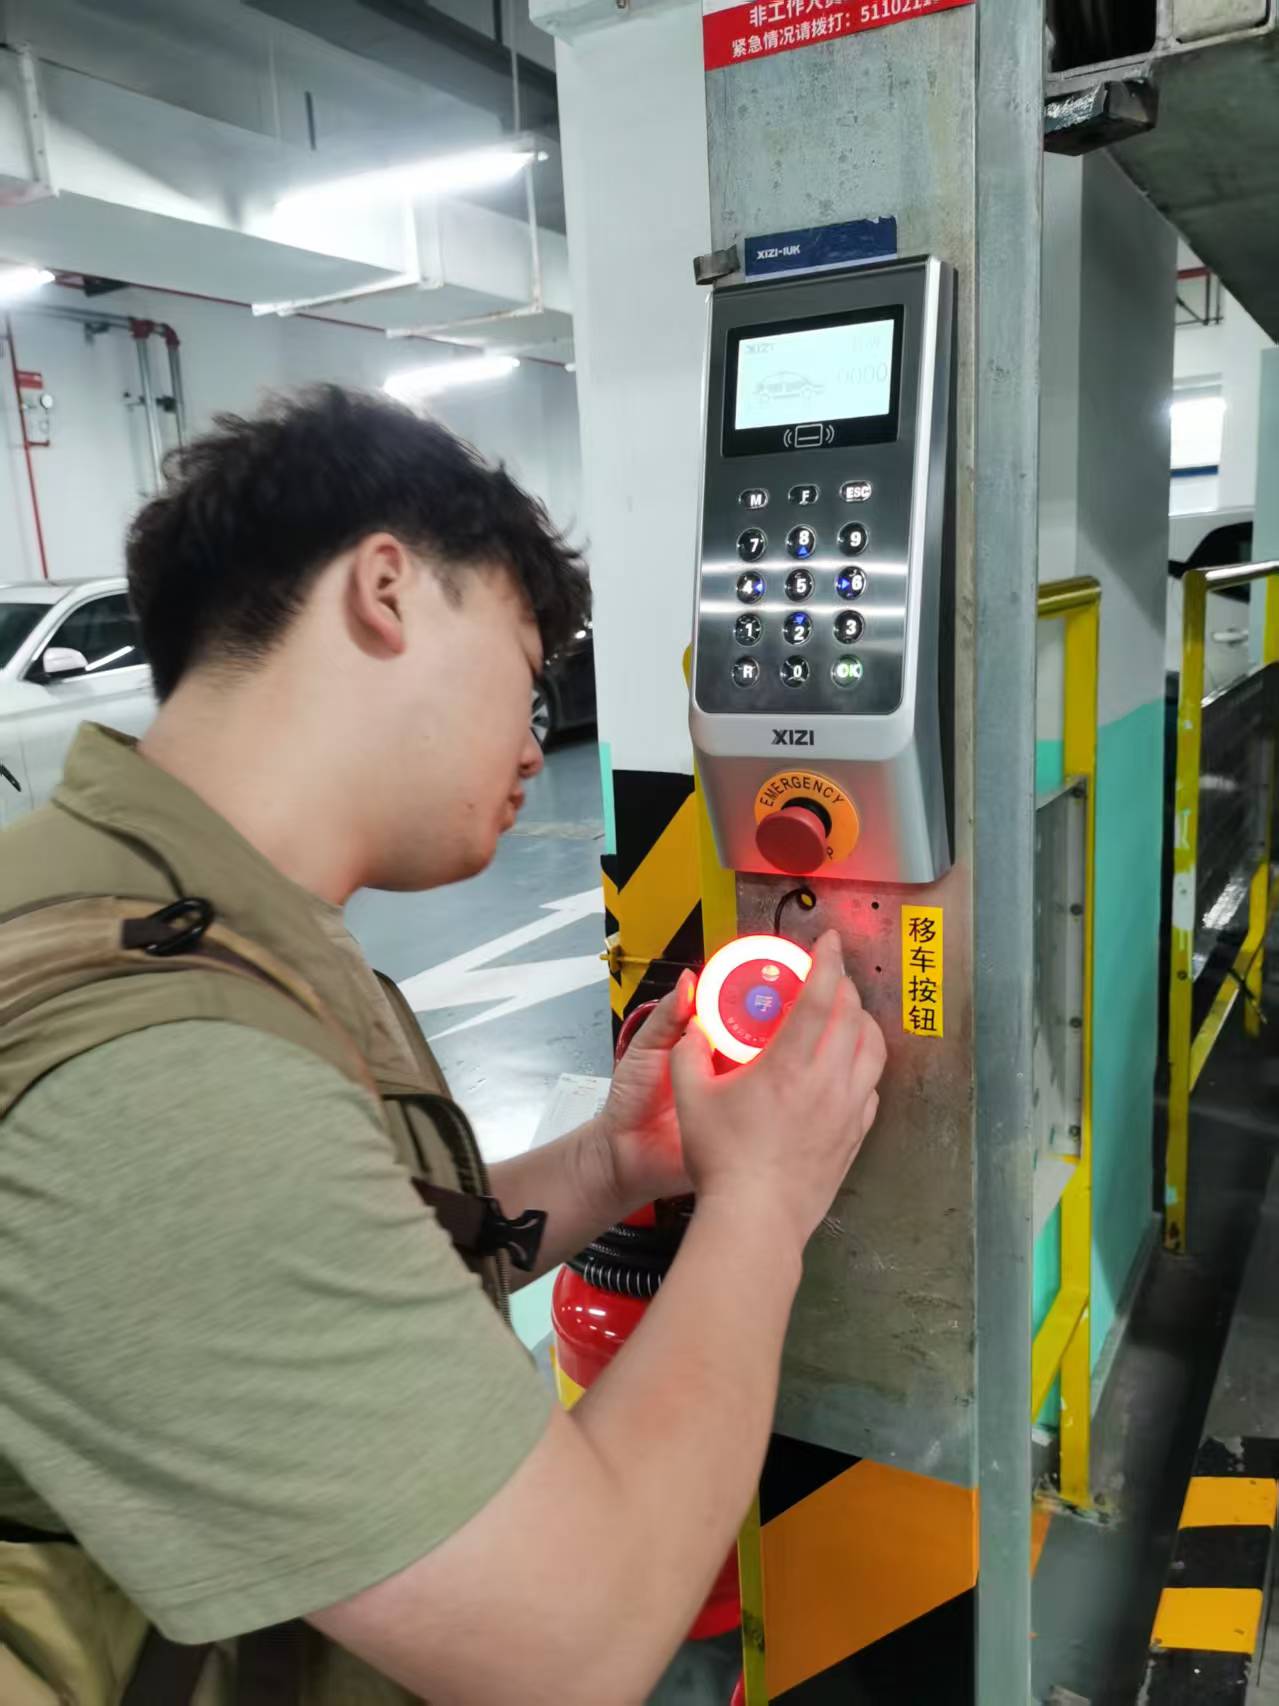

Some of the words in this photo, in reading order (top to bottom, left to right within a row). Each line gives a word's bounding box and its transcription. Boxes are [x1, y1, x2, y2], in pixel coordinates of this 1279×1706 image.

[750, 494, 762, 505] M
[802, 490, 810, 502] F
[846, 486, 870, 499] ESC
[750, 538, 759, 552] 7
[800, 530, 810, 545] 8
[850, 532, 861, 547] 9
[743, 580, 753, 594] 4
[797, 579, 806, 593] 5
[852, 575, 862, 590] 6
[745, 623, 753, 637] 1
[794, 626, 804, 640] 2
[846, 620, 857, 635] 3
[743, 665, 753, 678] R
[793, 664, 802, 678] 0
[837, 663, 862, 678] OK
[771, 729, 815, 746] XIZI
[759, 776, 845, 807] EMERGENCY
[908, 917, 937, 1032] 移车按钮
